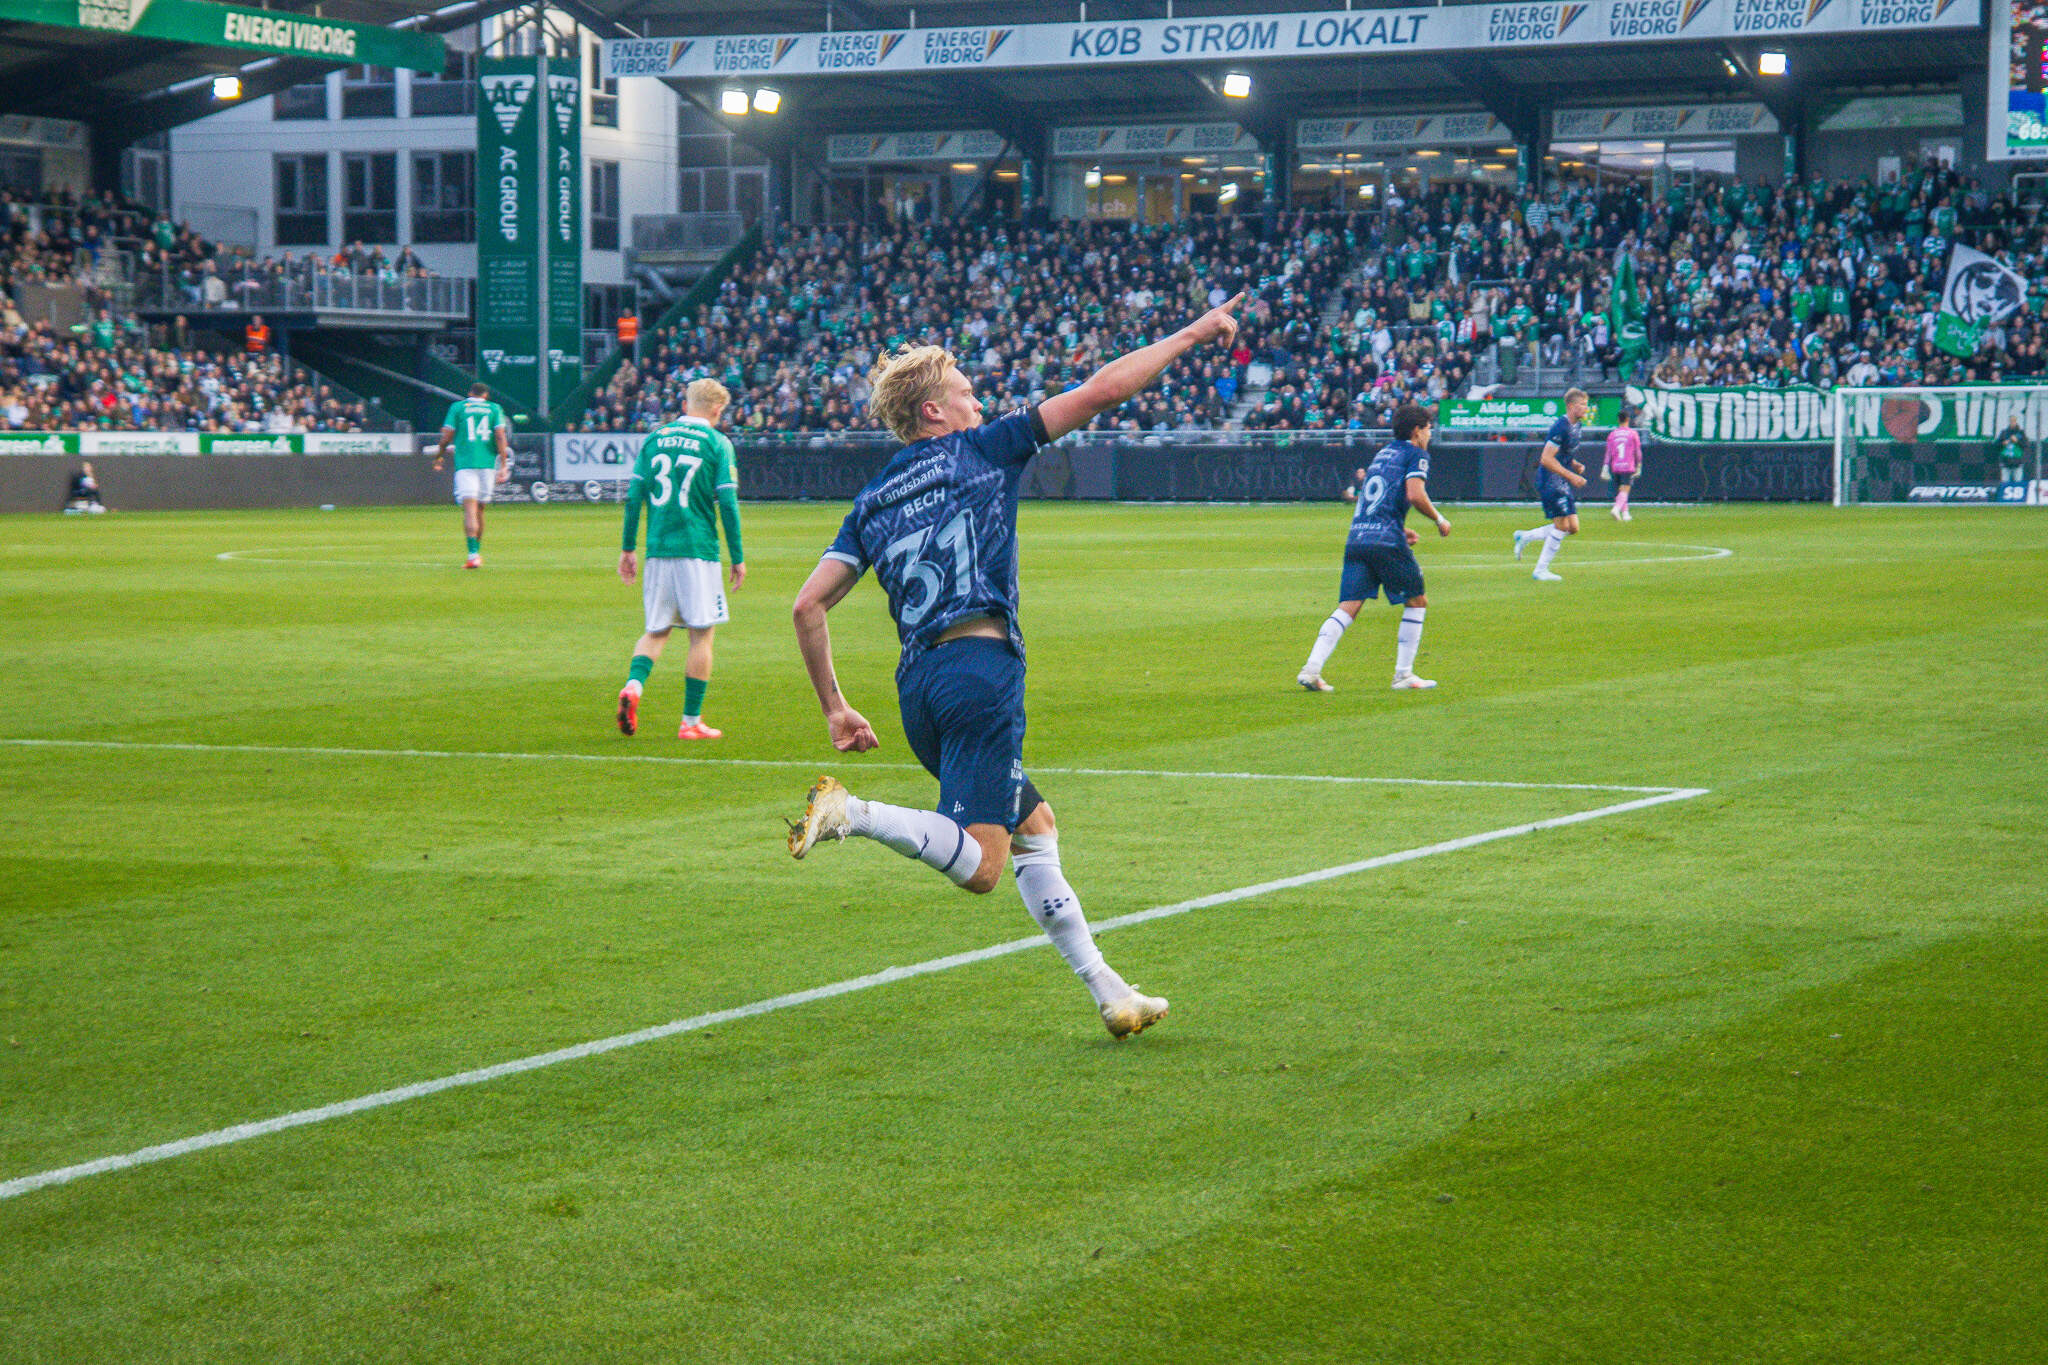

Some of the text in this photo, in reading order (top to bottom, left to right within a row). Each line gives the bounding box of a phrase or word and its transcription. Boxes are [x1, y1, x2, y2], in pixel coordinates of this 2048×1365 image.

[1490, 6, 1559, 24] ENERGI
[1611, 0, 1682, 18] ENERGI
[1861, 6, 1933, 24] VIBORG
[1609, 18, 1678, 36] VIBORG
[1733, 12, 1803, 31] VIBORG
[925, 30, 988, 48] ENERGI
[1069, 14, 1428, 57] KØB STRØM LOKALT
[1489, 23, 1555, 41] VIBORG
[612, 41, 671, 58] ENERGI
[715, 38, 774, 55] ENERGI
[819, 34, 881, 52] ENERGI
[713, 55, 772, 71] VIBORG
[817, 51, 878, 68] VIBORG
[923, 47, 985, 64] VIBORG
[611, 57, 668, 74] VIBORG
[500, 145, 518, 171] AC
[558, 145, 572, 241] AC GROUP
[500, 175, 519, 241] GROUP
[466, 415, 493, 441] 14
[657, 435, 701, 451] VESTER
[1616, 442, 1625, 459] 1
[649, 453, 703, 509] 37
[877, 463, 945, 506] Landsbank
[1909, 486, 1990, 498] AIRTOX
[902, 487, 947, 518] BECH
[884, 507, 980, 625] 31
